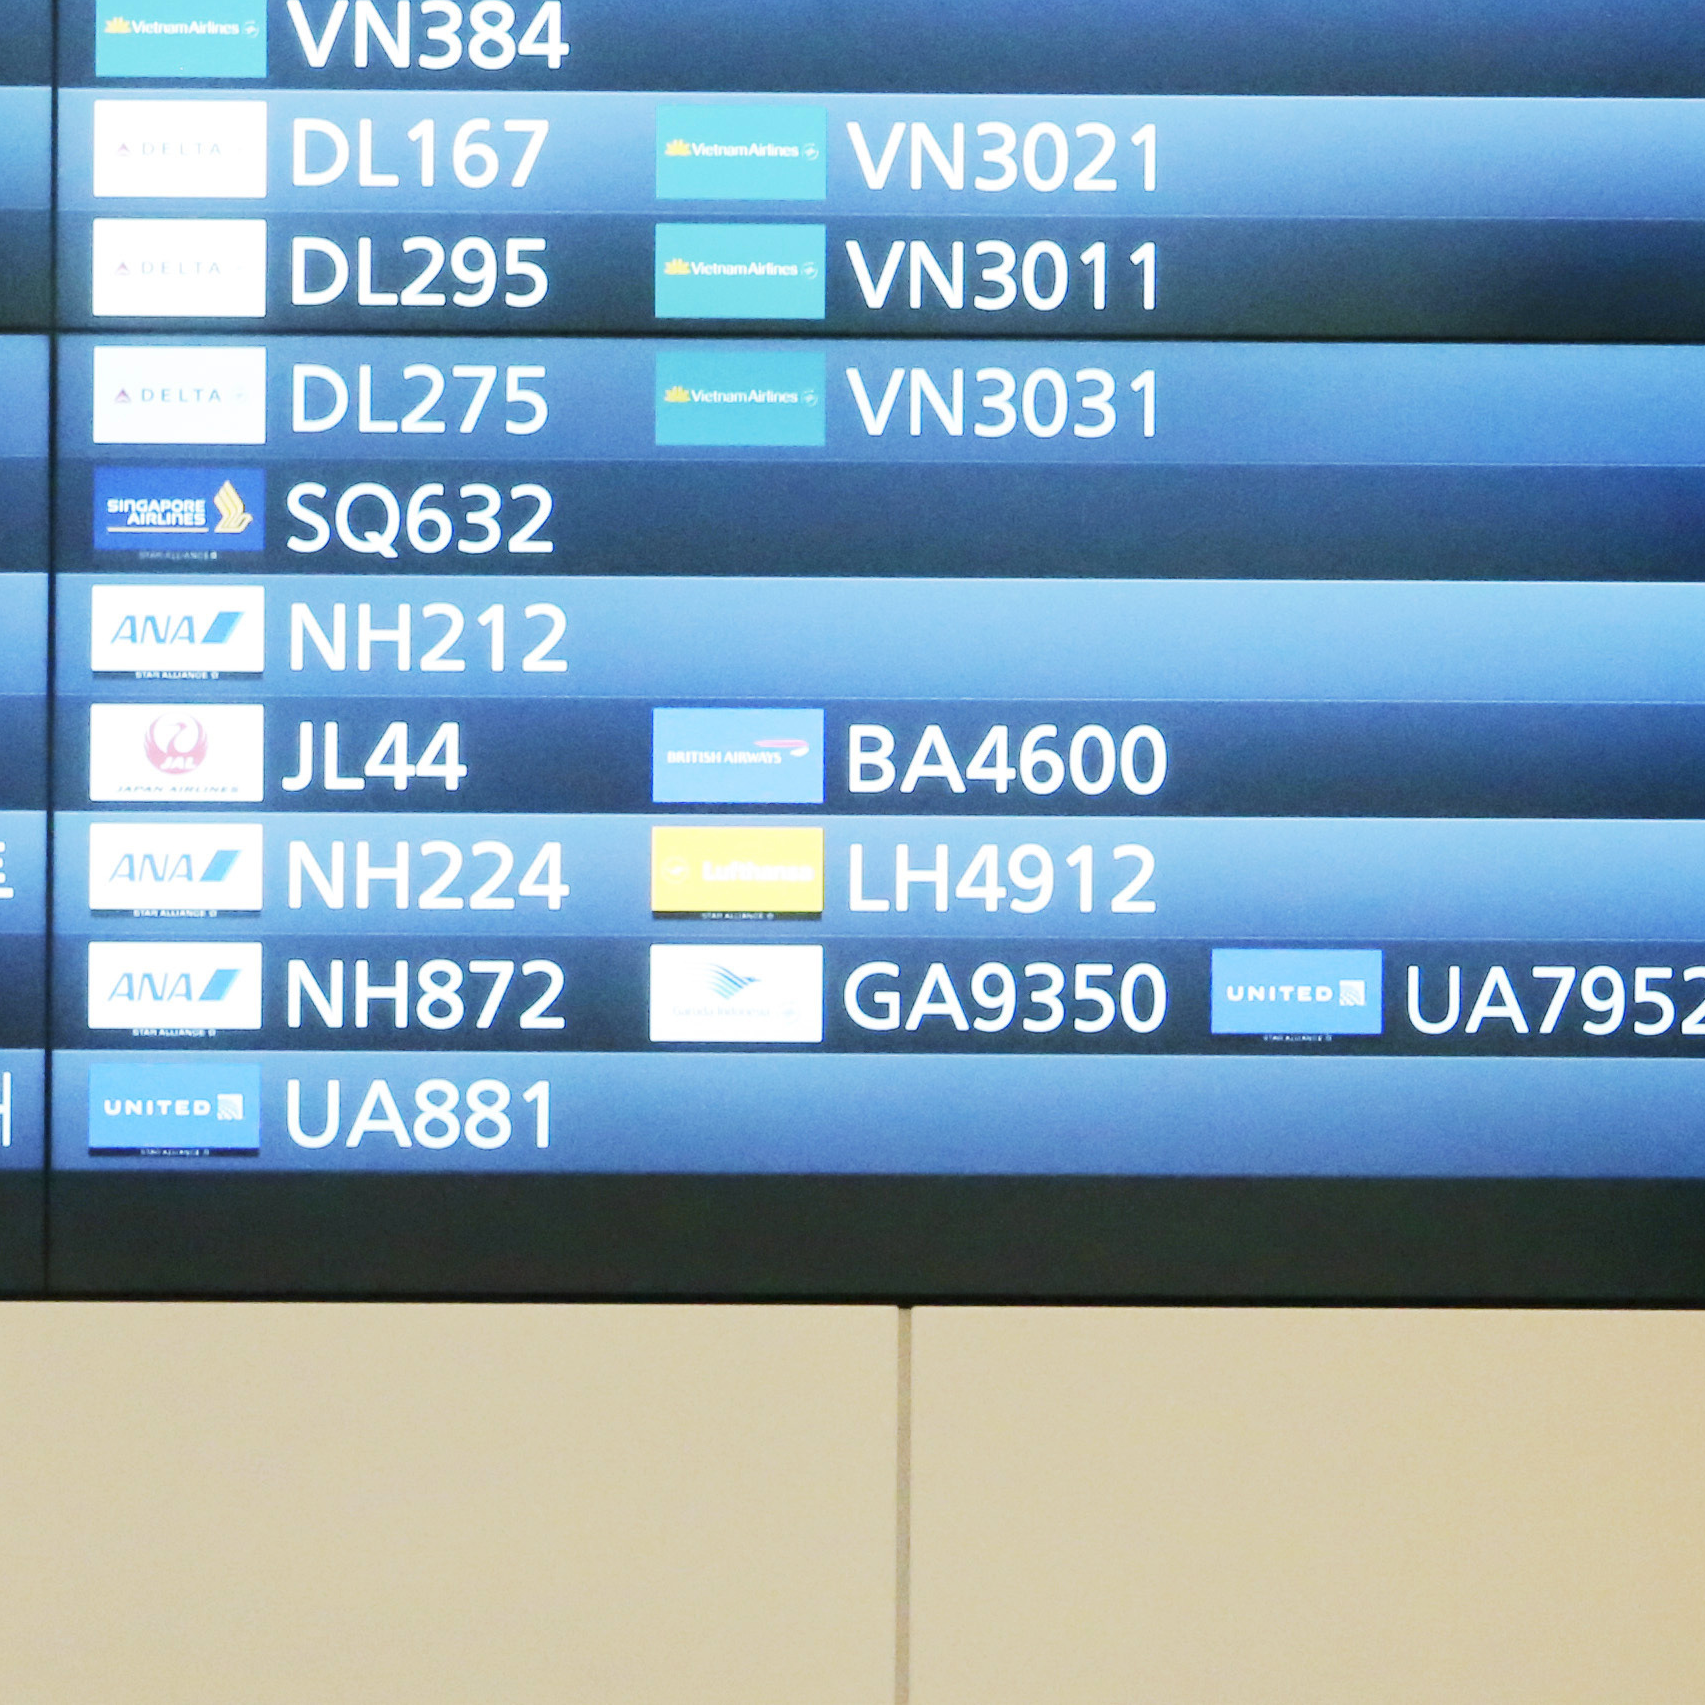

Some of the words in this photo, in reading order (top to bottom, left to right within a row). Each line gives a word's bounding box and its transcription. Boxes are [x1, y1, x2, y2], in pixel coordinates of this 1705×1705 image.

[287, 0, 569, 70] VN384
[292, 117, 550, 189] DL167
[846, 121, 1156, 192] VN3021
[292, 236, 548, 307] DL295
[845, 240, 1155, 310] VN3011
[293, 364, 548, 434] DL275
[846, 368, 1155, 438] VN3031
[107, 499, 206, 513] SINGAPORE
[127, 513, 206, 526] AIRLINES
[287, 483, 553, 558] SQ632
[290, 602, 568, 672] NH212
[282, 721, 467, 791] JL44
[849, 724, 1166, 795] BA4600
[288, 840, 570, 910] NH224
[849, 843, 1156, 914] LH4912
[288, 959, 565, 1029] NH872
[844, 961, 1166, 1033] GA9350
[103, 1098, 211, 1117] UNITED
[287, 1079, 549, 1149] UA881
